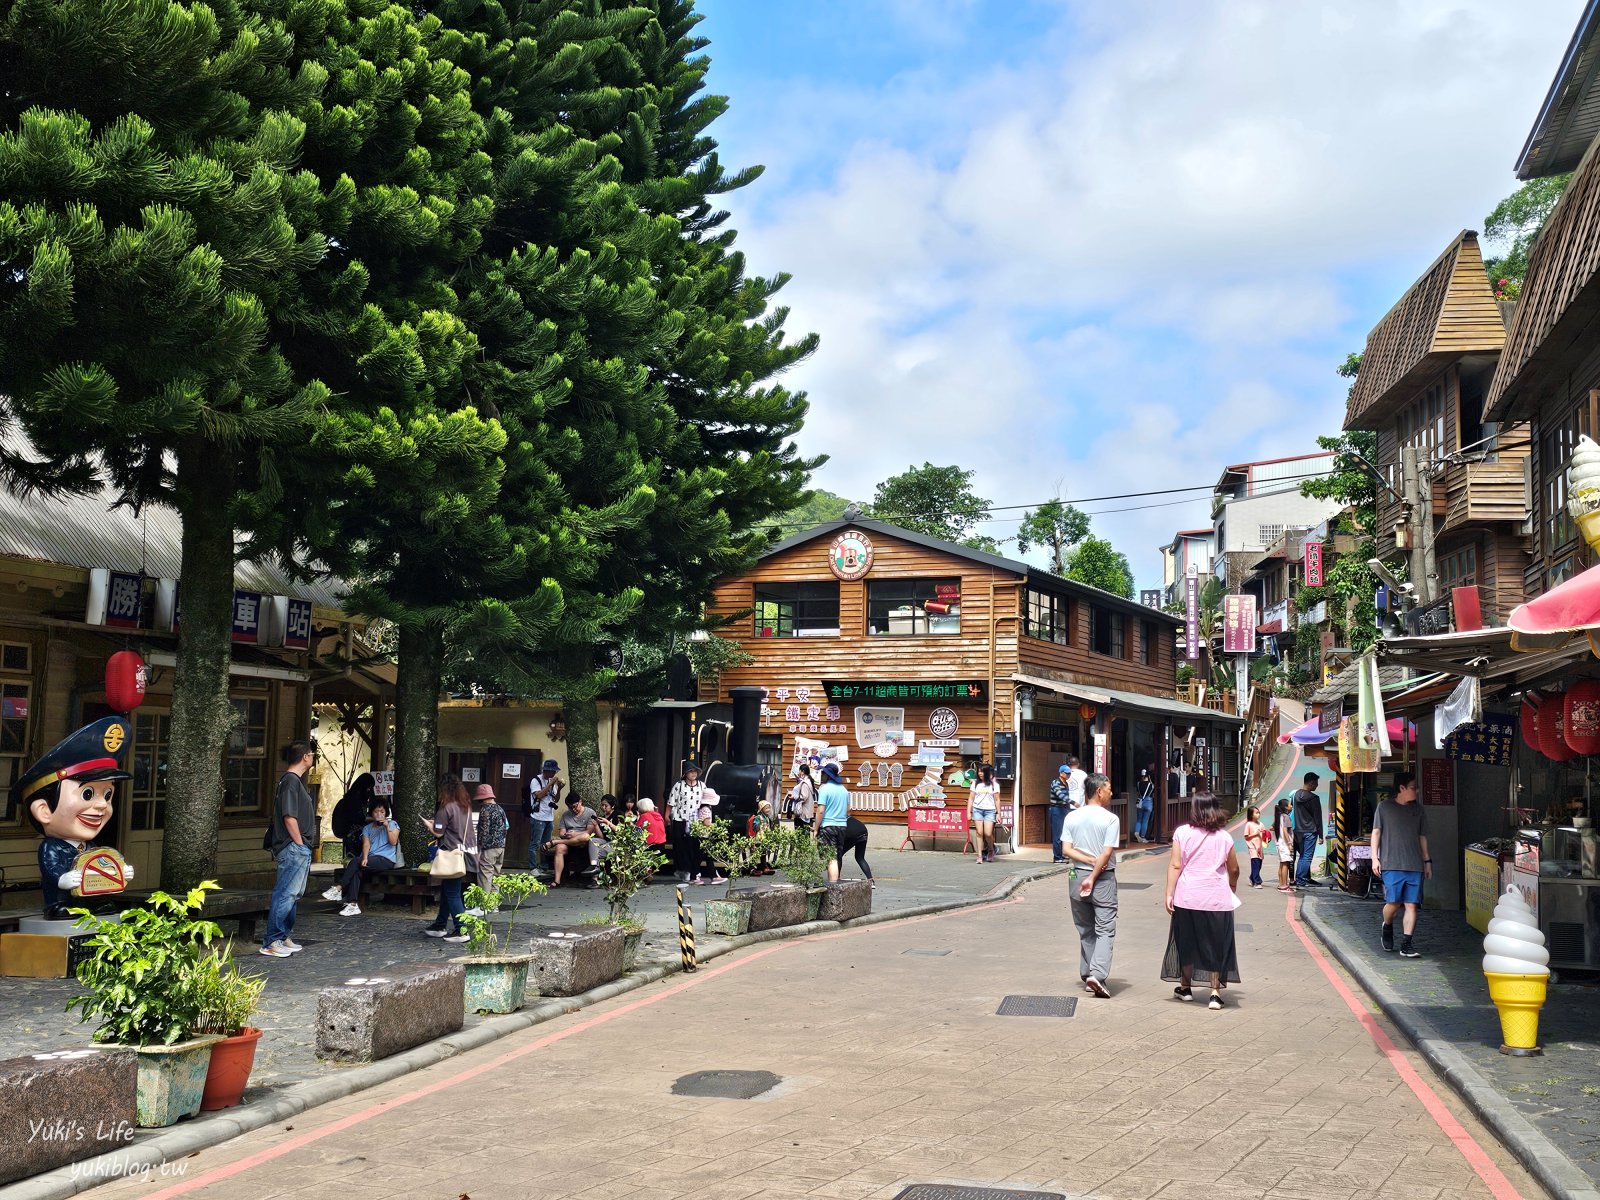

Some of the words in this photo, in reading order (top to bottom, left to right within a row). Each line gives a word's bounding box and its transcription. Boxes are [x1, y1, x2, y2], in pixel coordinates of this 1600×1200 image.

[109, 577, 311, 638] 勝車站
[831, 684, 969, 698] 全台7-11超商皆可預約訂票
[785, 704, 841, 721] 鐵定乖
[915, 809, 963, 824] 禁止停車
